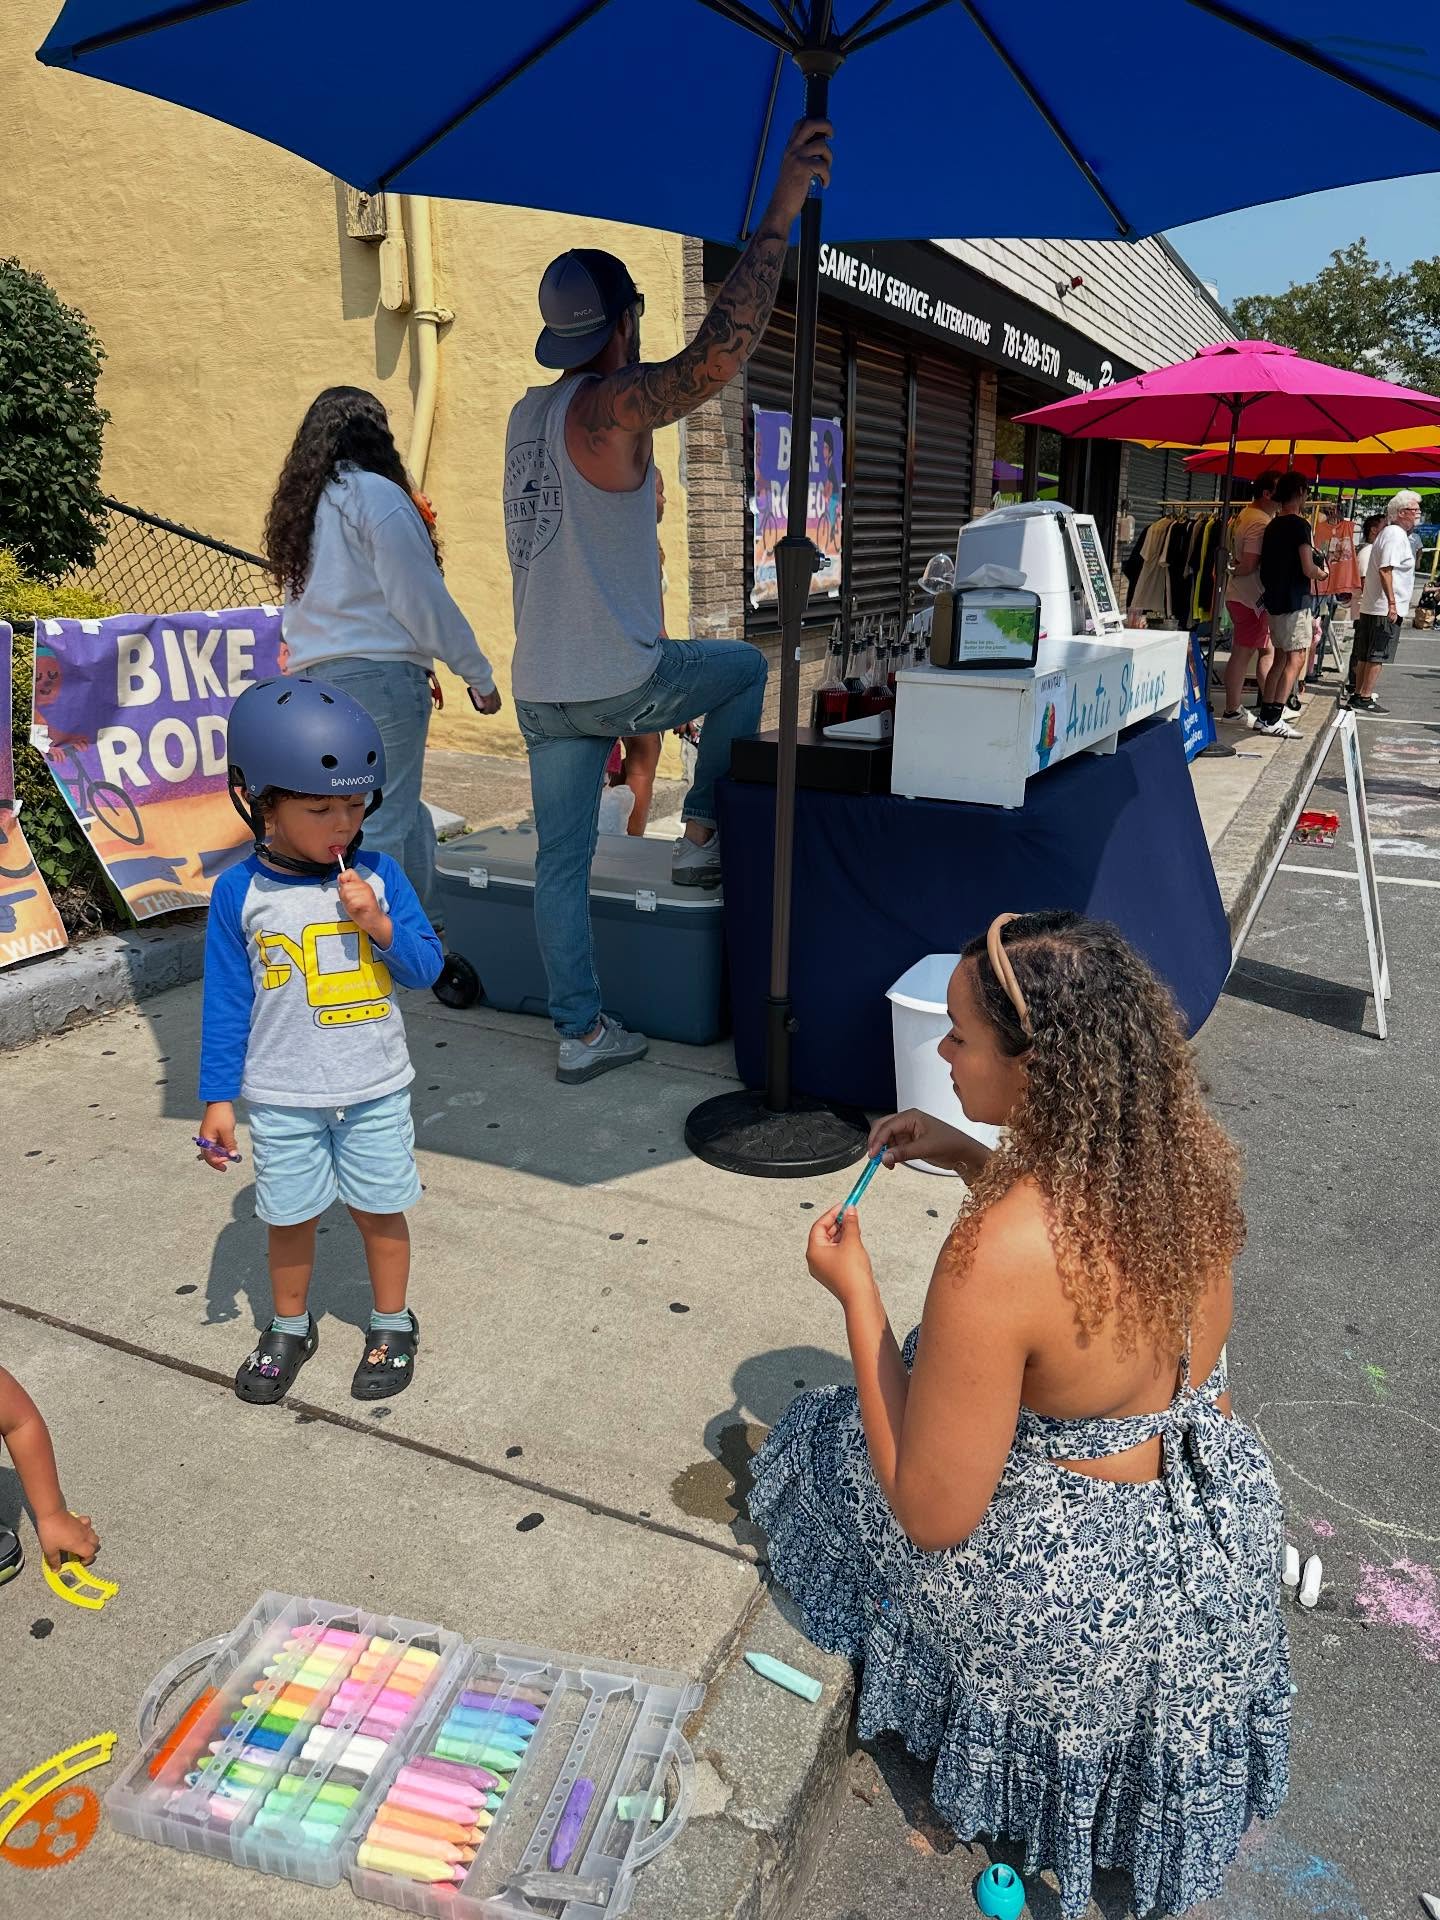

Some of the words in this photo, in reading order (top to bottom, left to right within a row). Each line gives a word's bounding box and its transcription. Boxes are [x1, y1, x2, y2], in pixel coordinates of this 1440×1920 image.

[818, 244, 859, 288] SAME
[858, 263, 886, 299] DAY
[884, 276, 930, 319] SERVICE
[933, 299, 991, 346] ALTERATIONS
[1002, 322, 1060, 378] 781-289-1570
[778, 426, 820, 473] BE
[770, 480, 826, 519] ROEO
[117, 628, 257, 708] BIKE
[1119, 663, 1166, 717] Shavings
[97, 715, 228, 790] ROD
[331, 774, 375, 787] BANWOOD
[137, 891, 182, 914] THIS
[0, 927, 64, 962] WAY!
